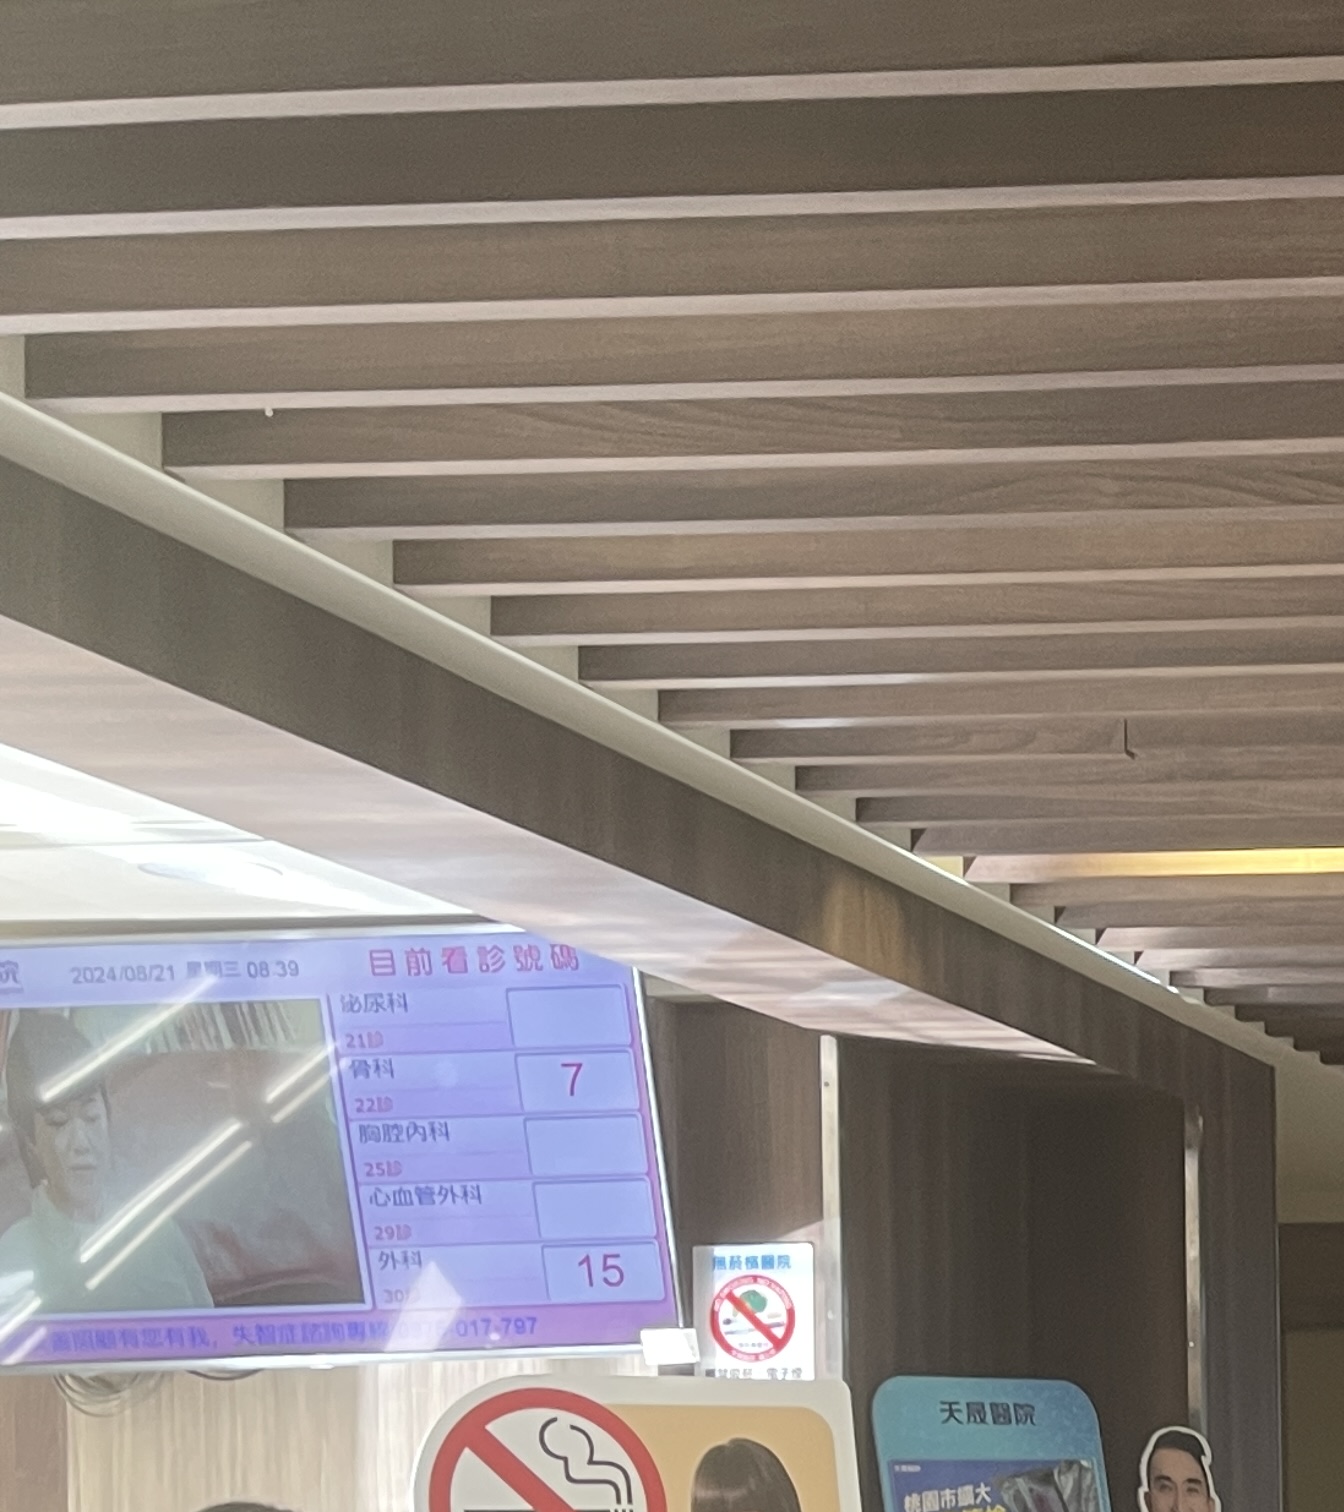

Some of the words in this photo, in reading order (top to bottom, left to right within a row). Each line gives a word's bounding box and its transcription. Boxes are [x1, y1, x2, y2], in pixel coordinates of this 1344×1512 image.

[369, 943, 579, 977] 目前看診號碼
[70, 964, 175, 985] 2024/08/21
[339, 991, 409, 1014] 泌尿科
[349, 1057, 395, 1080] 骨科
[560, 1062, 583, 1097] 7
[358, 1120, 451, 1144] 胸腔內科
[369, 1183, 483, 1208] 心血管外科
[377, 1249, 423, 1271] 外科
[577, 1253, 625, 1288] 15
[939, 1400, 1037, 1427] 天晟醫院
